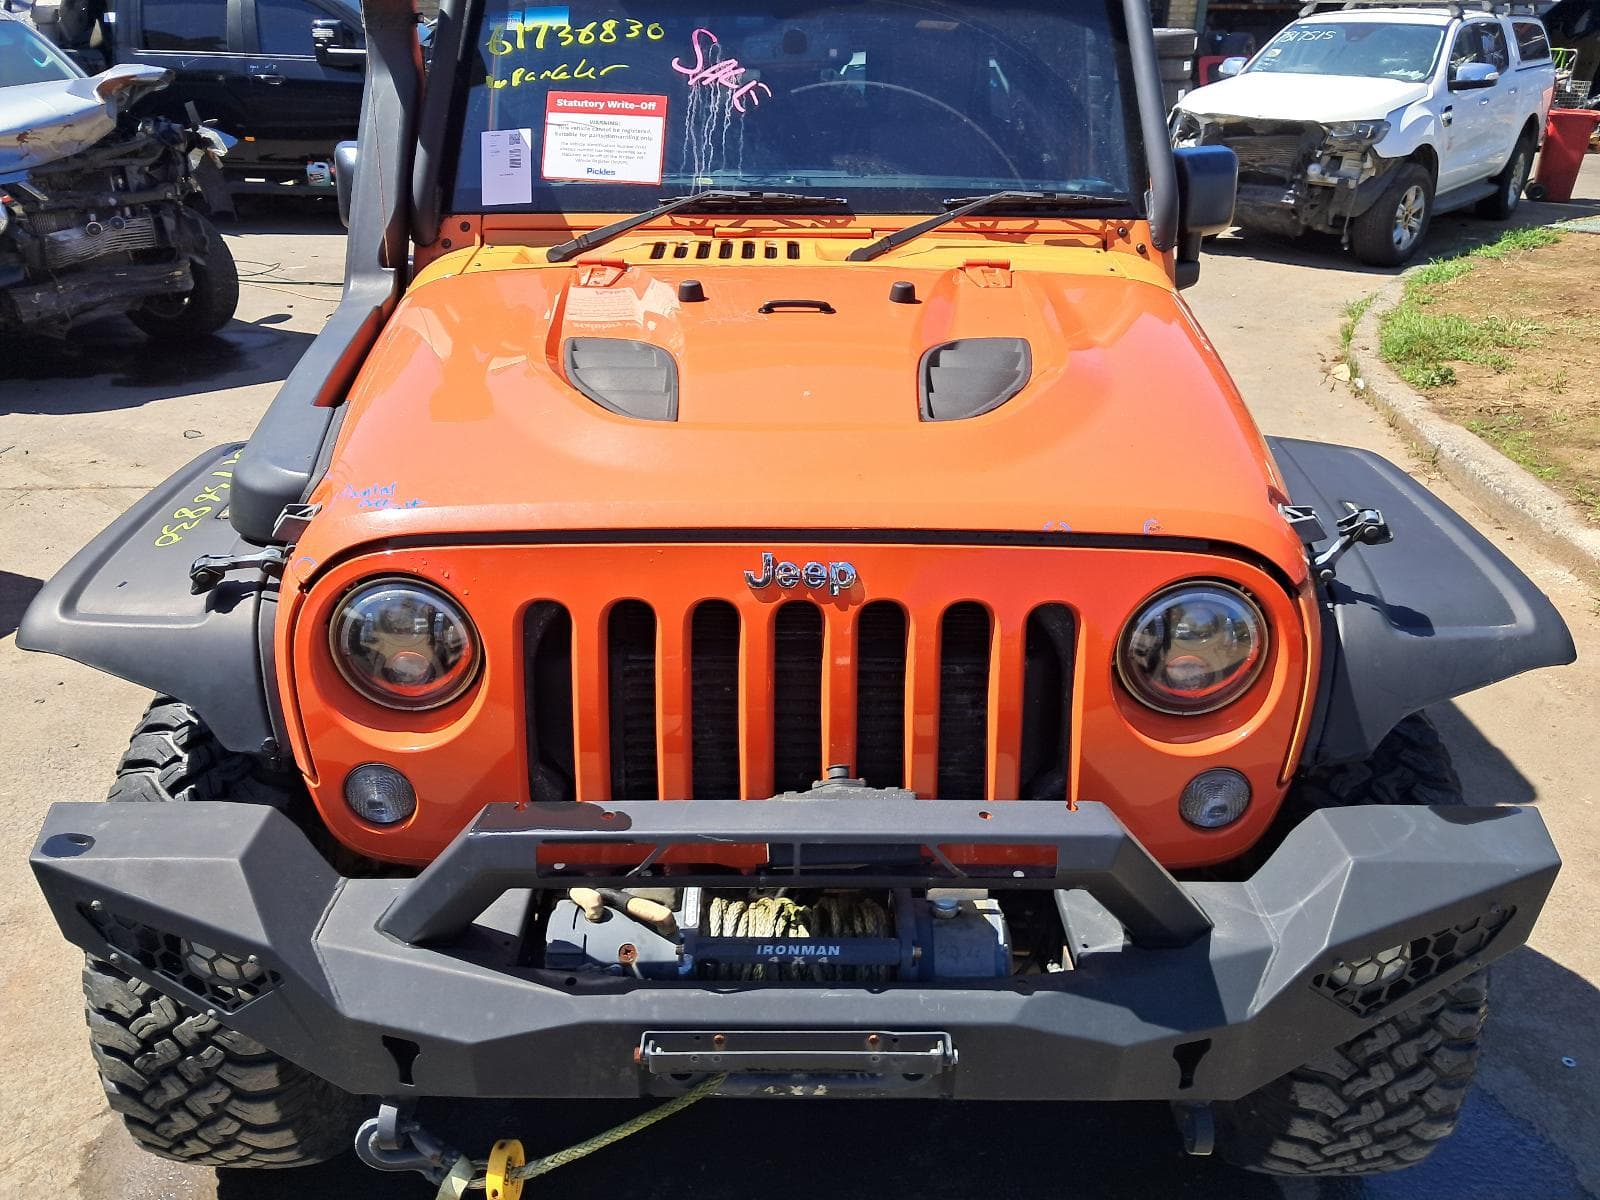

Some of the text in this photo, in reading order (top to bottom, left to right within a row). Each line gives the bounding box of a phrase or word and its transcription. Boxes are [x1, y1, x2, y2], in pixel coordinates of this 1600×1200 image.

[556, 98, 657, 110] Statutory Write-Off
[586, 167, 616, 176] Pickles
[743, 552, 857, 595] Jeep
[756, 944, 840, 956] IRONMAN
